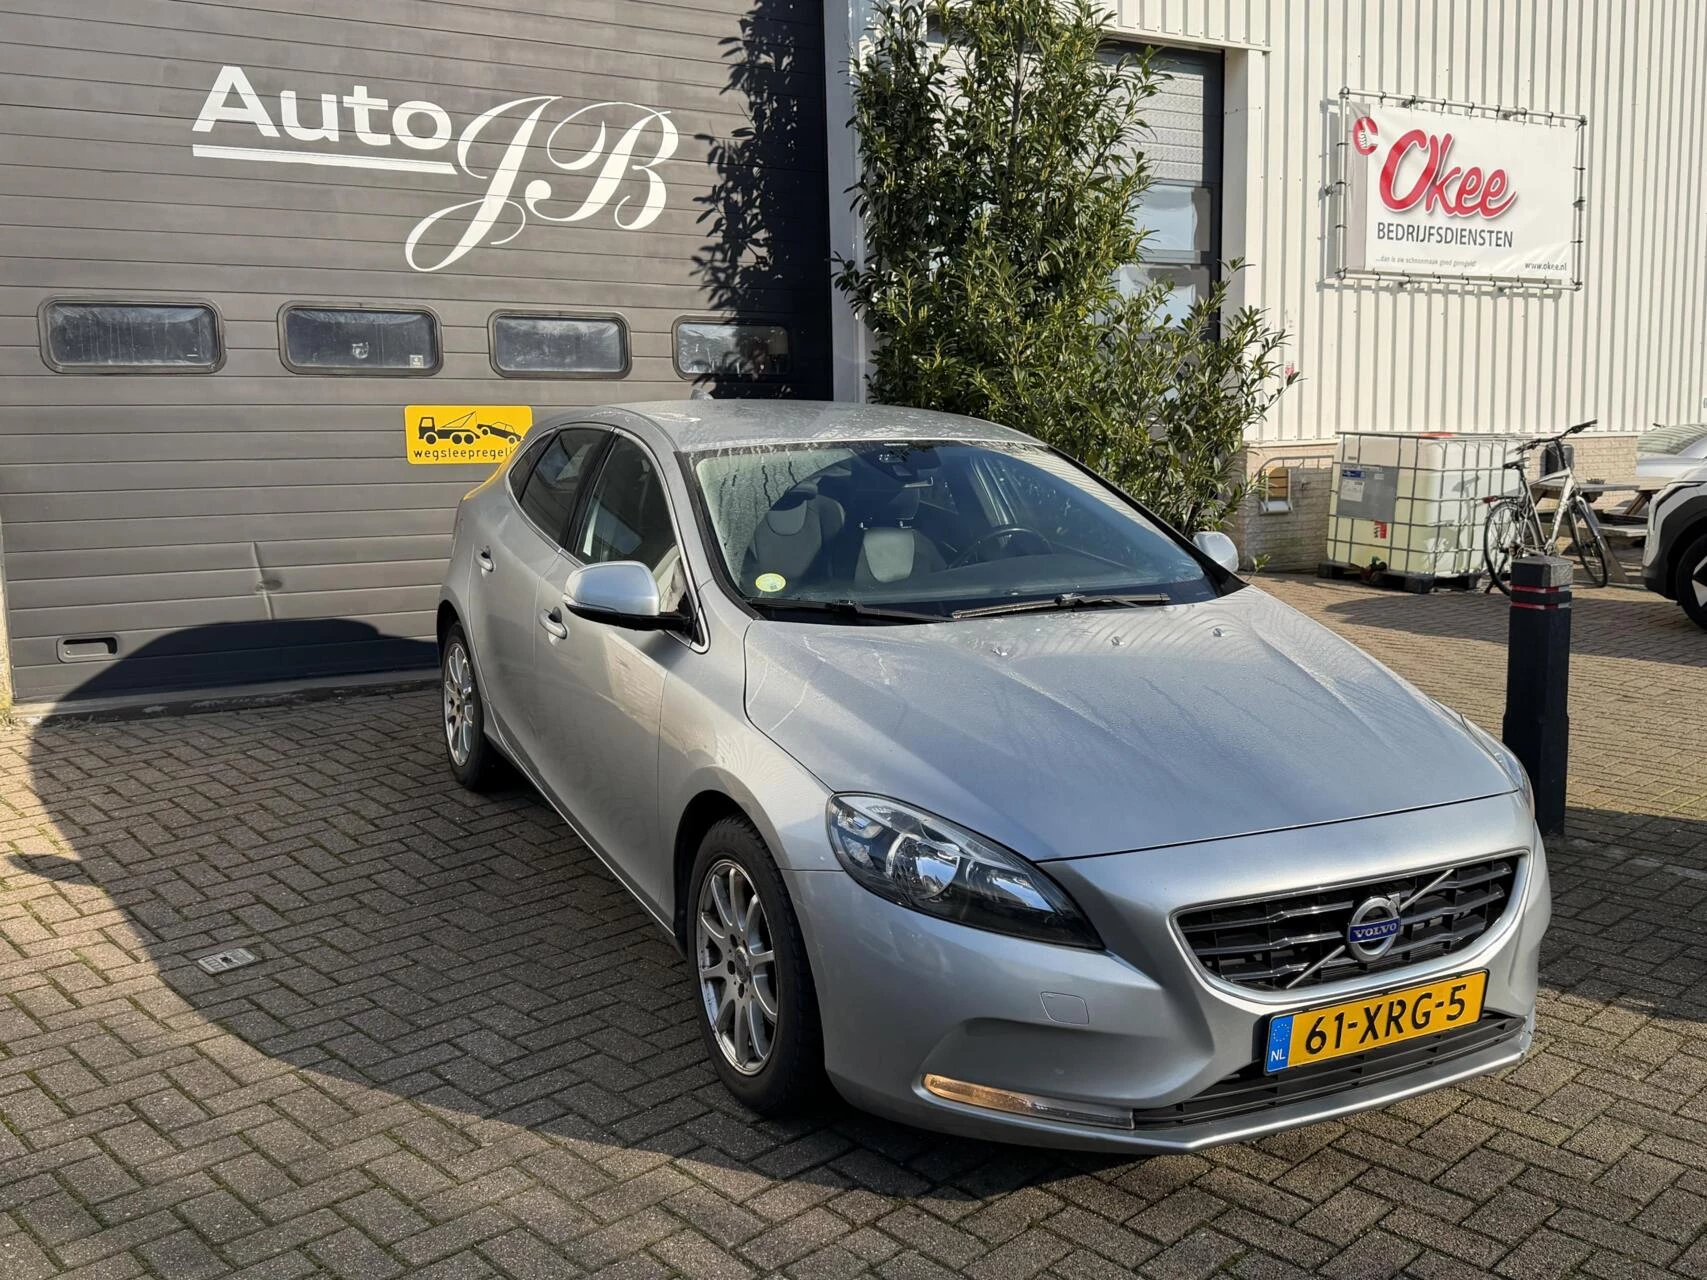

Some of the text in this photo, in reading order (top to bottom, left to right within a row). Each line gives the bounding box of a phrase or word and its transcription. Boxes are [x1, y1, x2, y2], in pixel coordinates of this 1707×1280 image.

[192, 65, 679, 272] Auto JB
[1377, 221, 1513, 248] BEDRIJFSDIENSTEN
[1354, 922, 1398, 938] VOLVO
[1271, 984, 1466, 1062] NL 61-XRG-5
